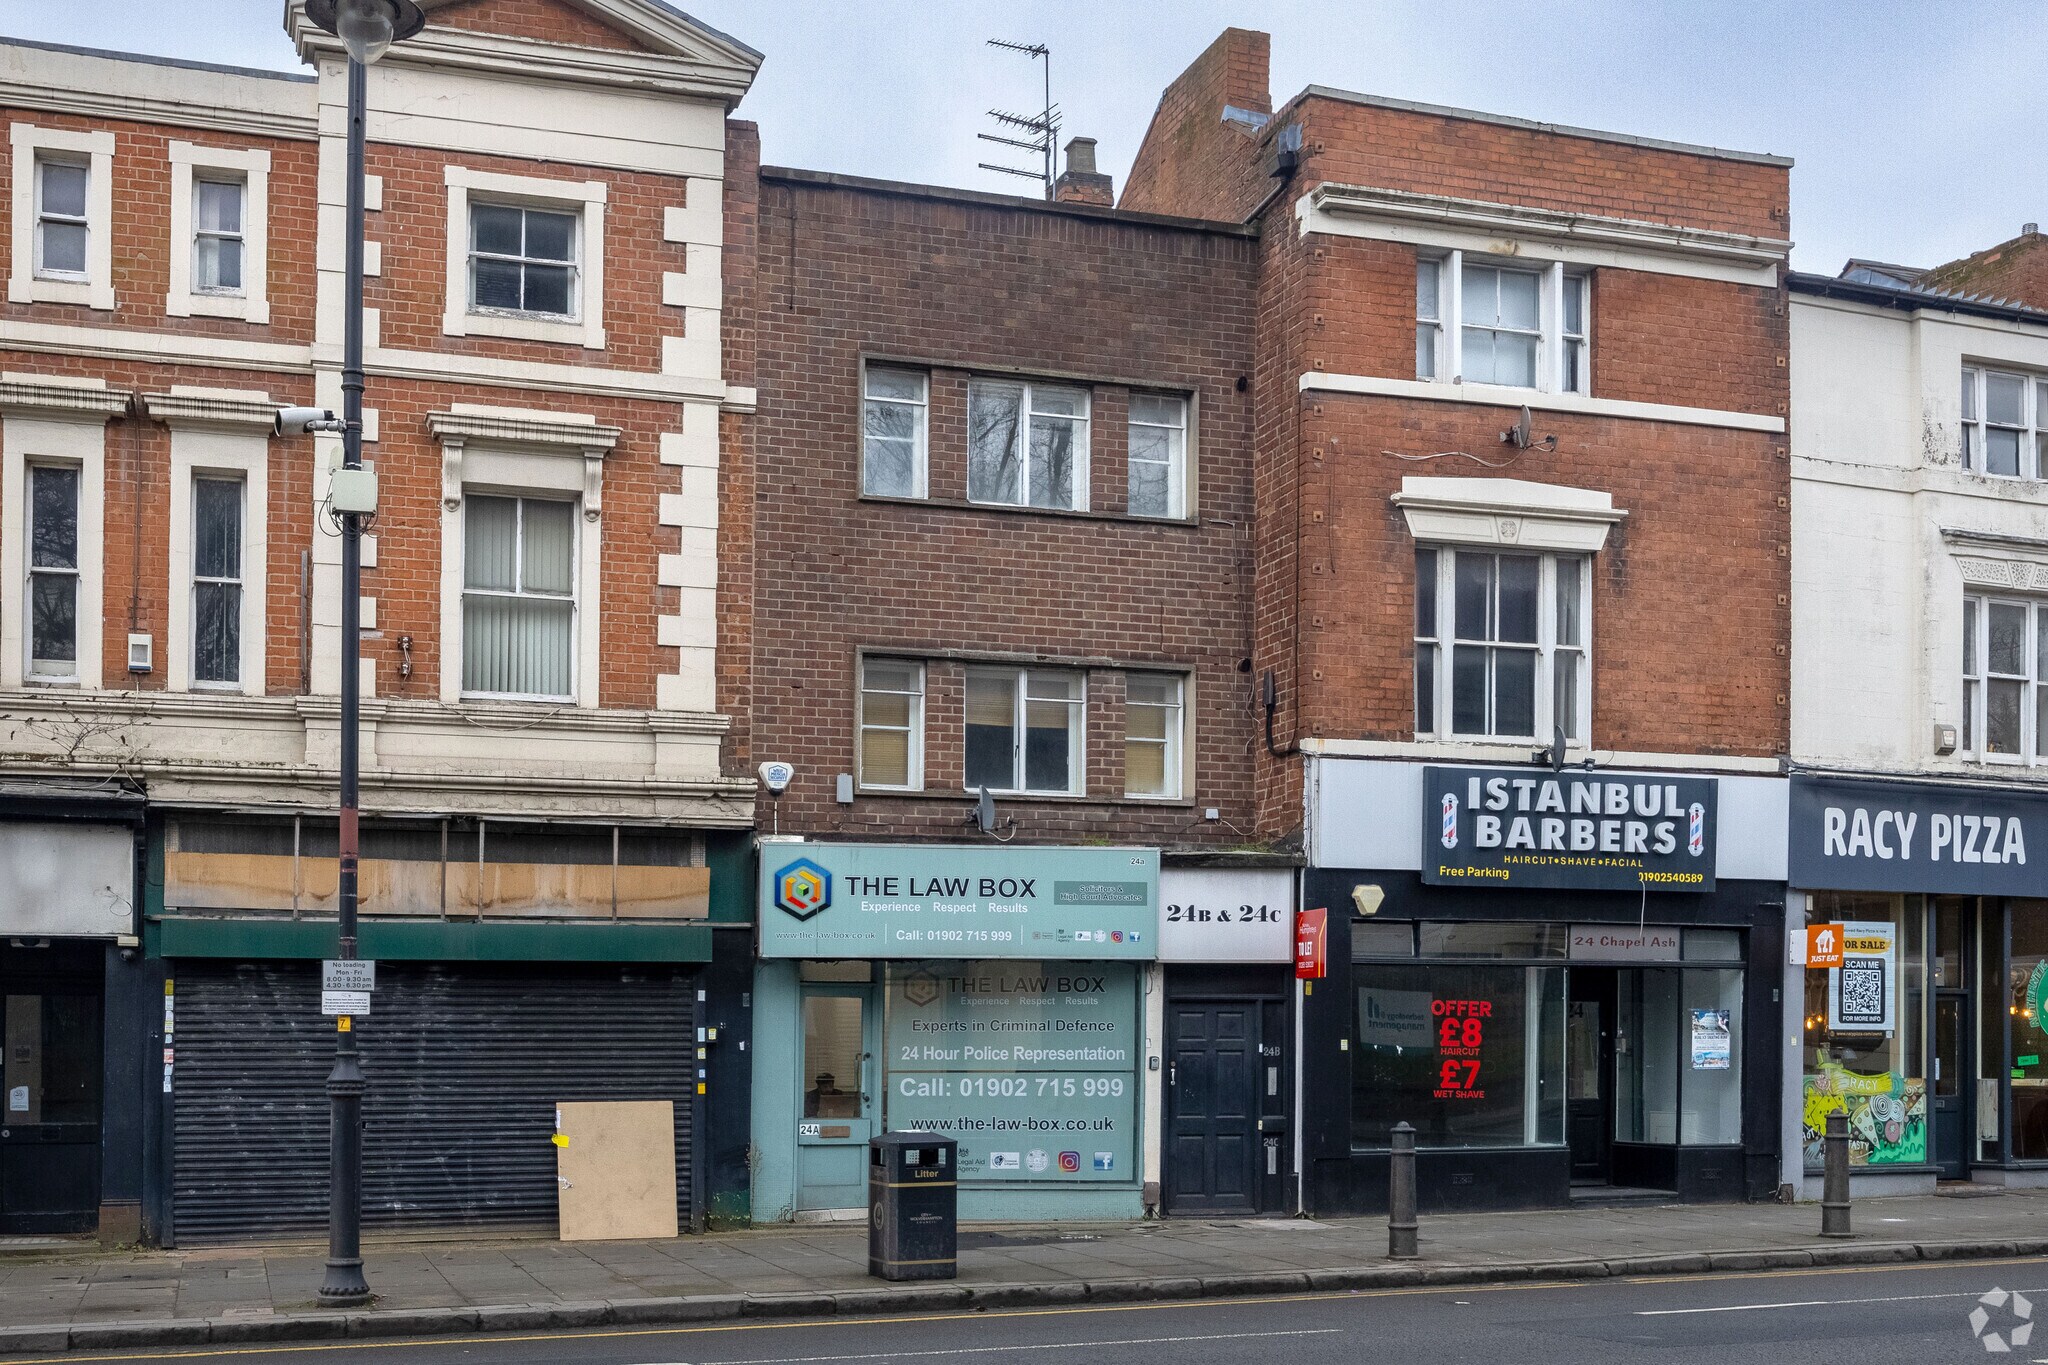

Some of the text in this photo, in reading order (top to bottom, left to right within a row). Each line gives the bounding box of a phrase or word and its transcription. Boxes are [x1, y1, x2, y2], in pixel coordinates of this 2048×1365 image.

[1468, 776, 1685, 817] ISTANBUL
[1476, 815, 1676, 854] BARBERS
[1824, 807, 2026, 865] RACY PIZZA
[1130, 857, 1145, 865] 24a
[1440, 866, 1509, 880] Free Parking
[844, 876, 1037, 898] THE LAW BOX
[861, 901, 1028, 914] Experience Respect Results
[1166, 904, 1212, 922] 24B
[1216, 909, 1232, 922] &
[896, 930, 1012, 941] Call: 01902 715 999
[1574, 935, 1676, 950] 24 Chapel Ash
[1844, 940, 1886, 949] OR SALE
[1811, 954, 1839, 963] JUST EAT
[1845, 960, 1880, 969] SCAN ME
[948, 976, 1106, 993] THE LAW BOX
[960, 996, 1099, 1007] Experience Respect Results
[1431, 999, 1492, 1017] OFFER
[340, 1019, 345, 1028] 7
[912, 1019, 1115, 1034] Experts in Criminal Defence
[1440, 1017, 1482, 1047] £8
[901, 1046, 1125, 1063] 24 Hour Police Representation
[1263, 1046, 1280, 1056] 24B
[1440, 1047, 1480, 1056] HAIRCUT
[1440, 1059, 1481, 1089] £7
[900, 1077, 1124, 1097] Call: 01902 715 999
[1850, 1078, 1878, 1090] RACY
[1433, 1090, 1485, 1099] WET SHAVE
[800, 1125, 819, 1135] 24A
[910, 1116, 1114, 1131] www.the-law-box.co.uk
[1263, 1138, 1279, 1147] 24C
[957, 1158, 973, 1167] Legal
[914, 1170, 939, 1178] Litter
